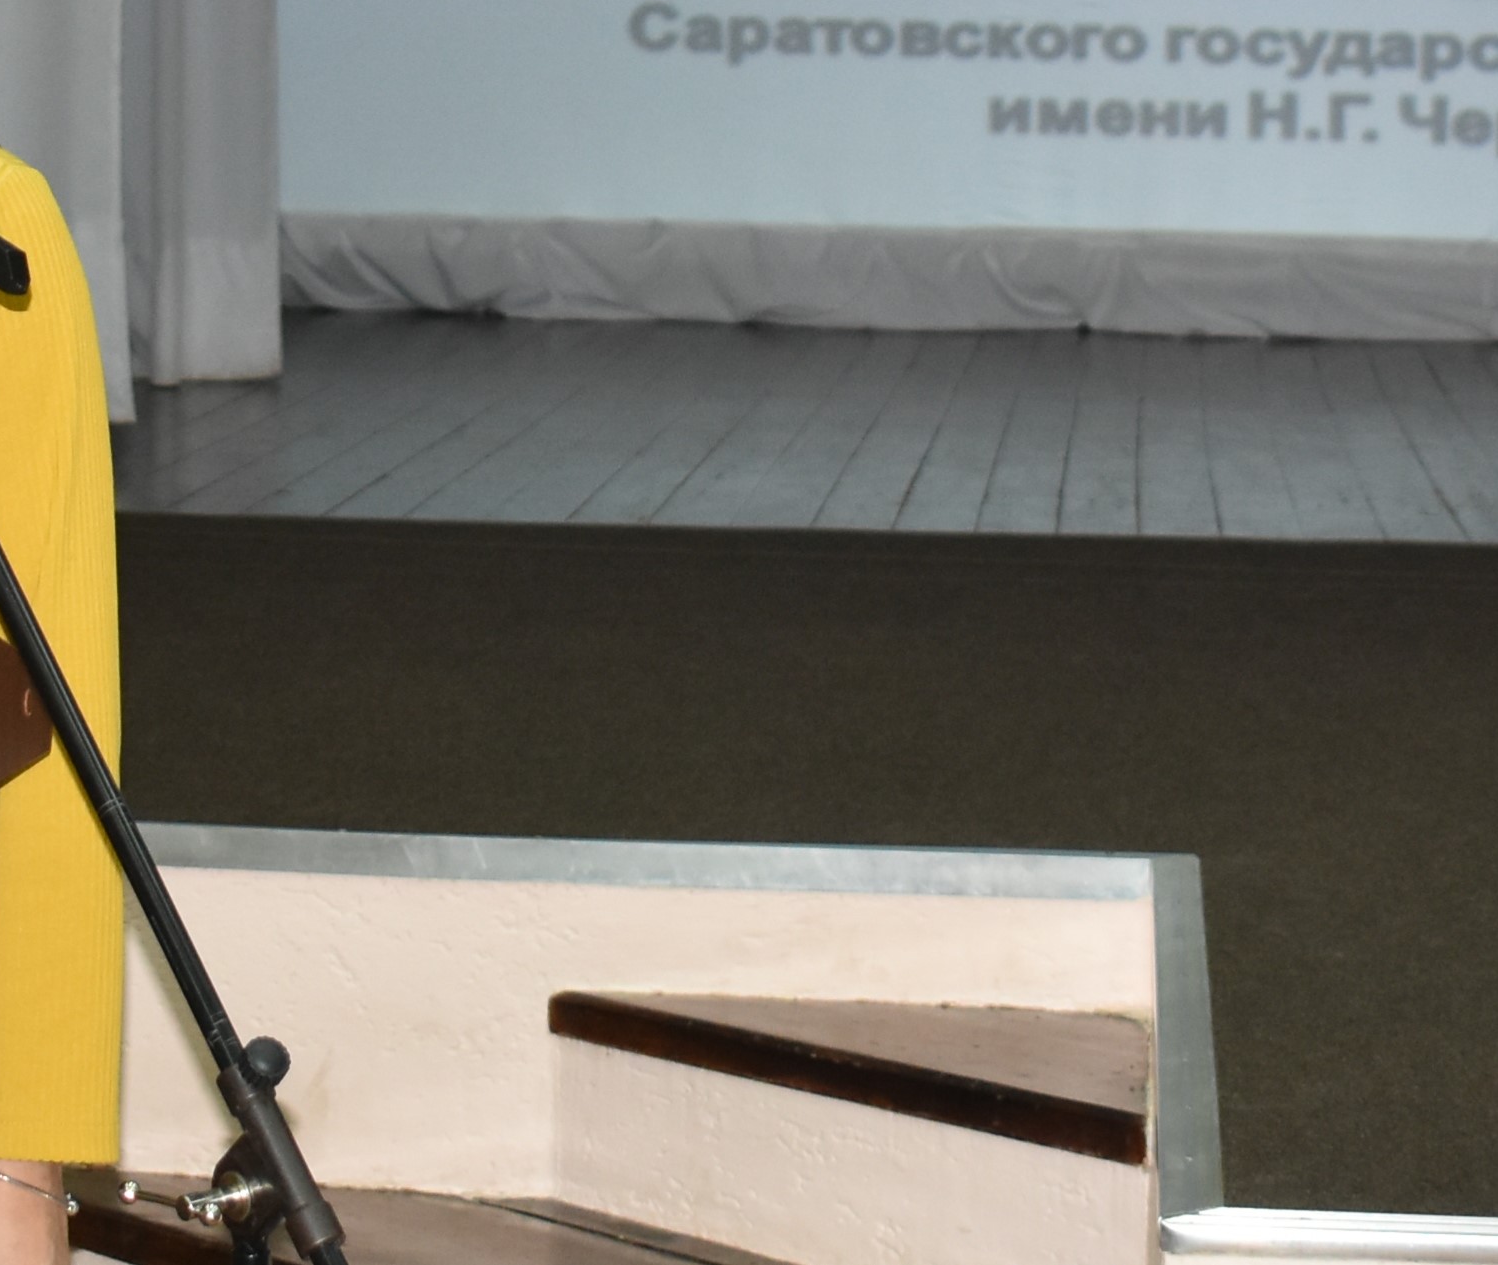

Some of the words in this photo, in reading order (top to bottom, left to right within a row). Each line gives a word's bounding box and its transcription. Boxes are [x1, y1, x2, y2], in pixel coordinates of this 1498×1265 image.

[629, 3, 1147, 66] Саратовского
[989, 98, 1227, 138] имени
[1249, 92, 1378, 142] Н.Г.
